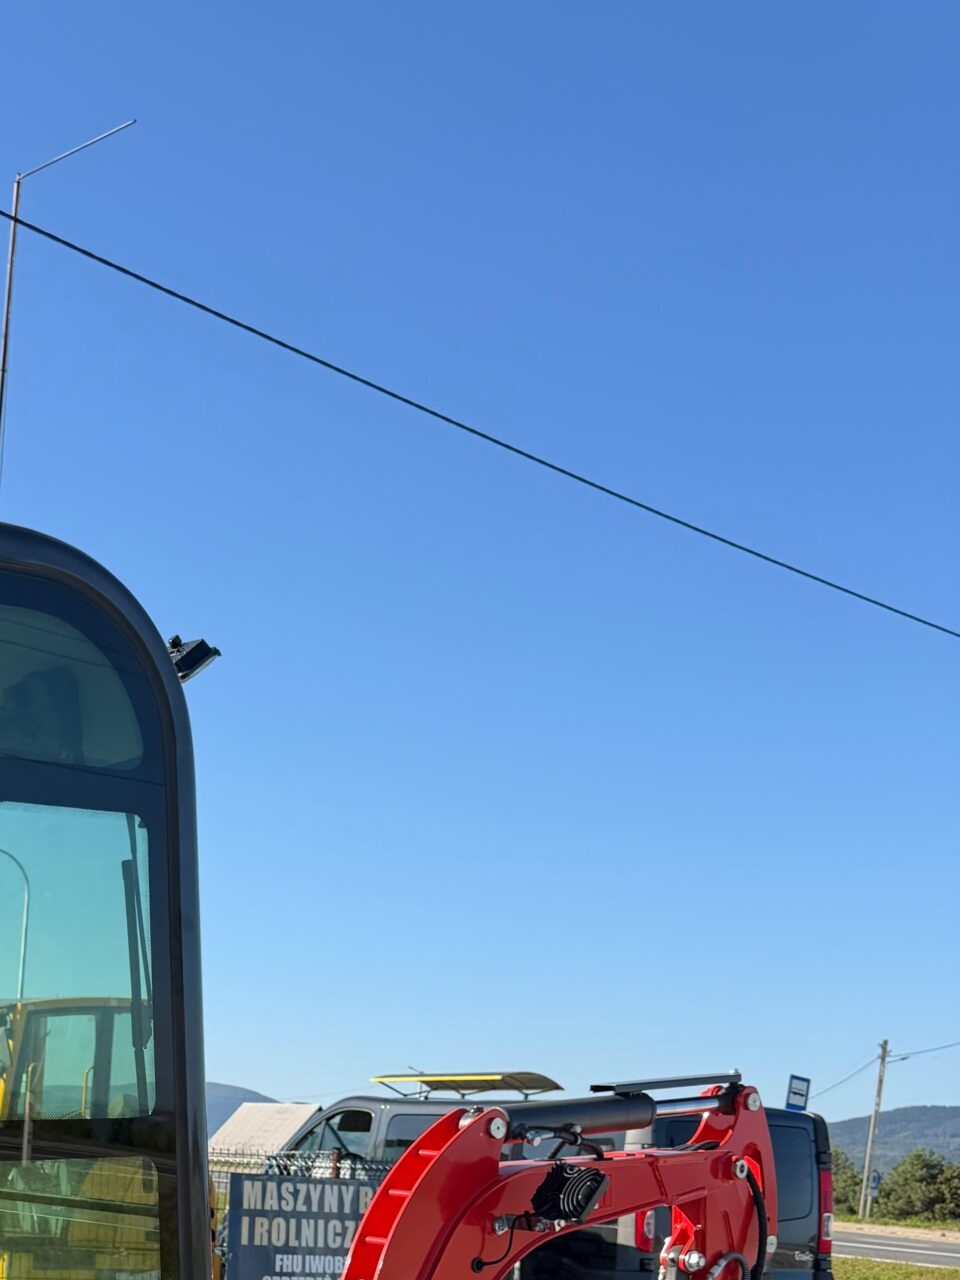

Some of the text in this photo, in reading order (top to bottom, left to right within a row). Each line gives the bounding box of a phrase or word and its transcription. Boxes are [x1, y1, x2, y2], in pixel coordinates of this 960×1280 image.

[242, 1180, 355, 1214] MASZYNY
[240, 1216, 356, 1249] I ROLNICZ
[275, 1253, 346, 1274] FHU IWOB
